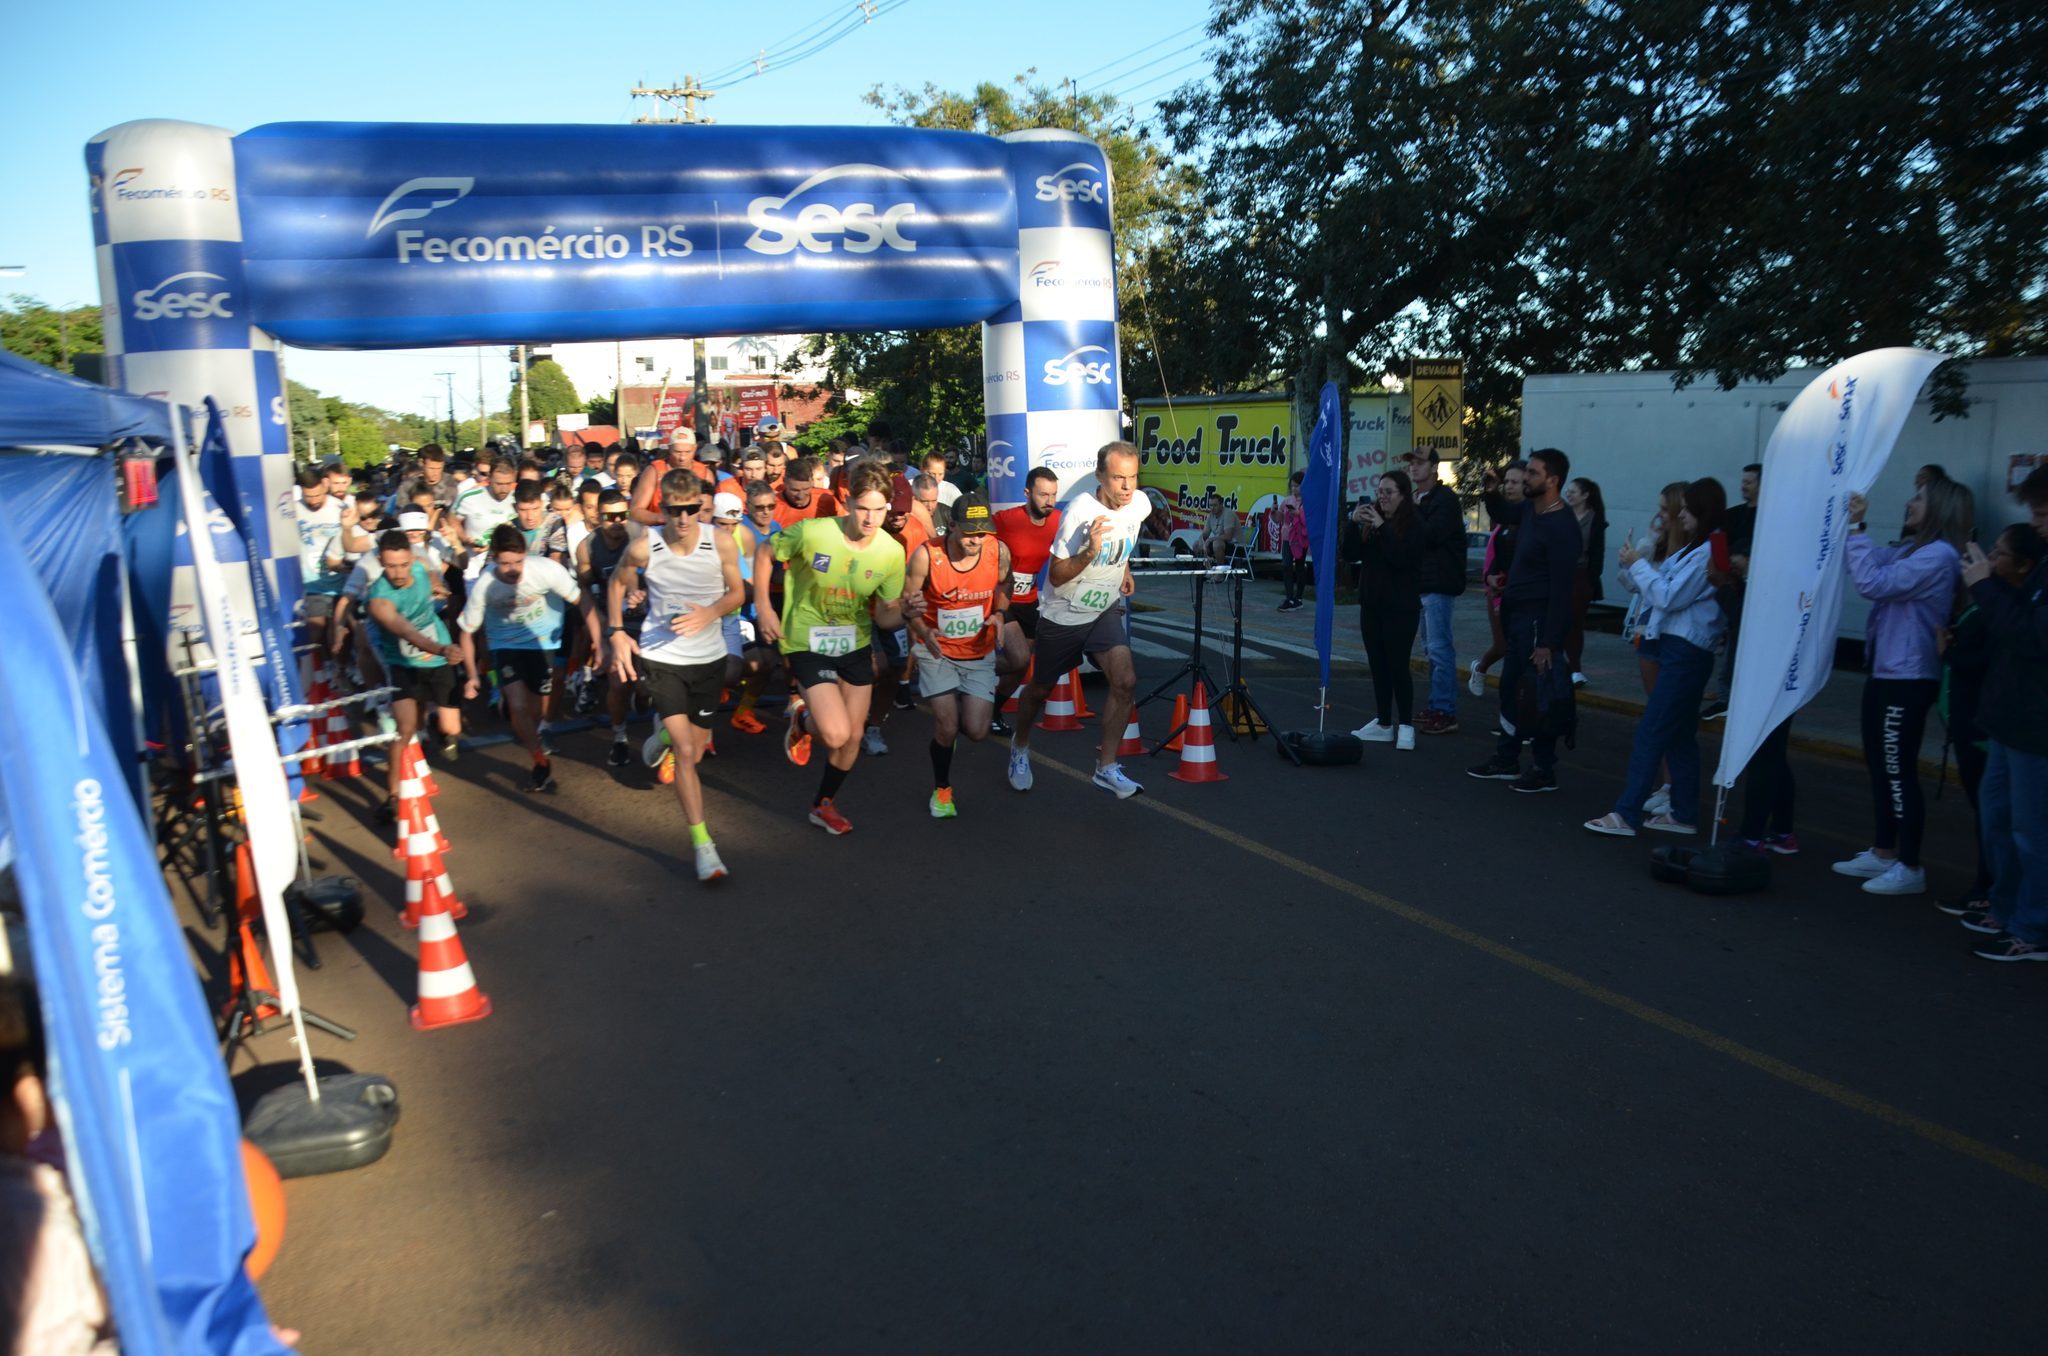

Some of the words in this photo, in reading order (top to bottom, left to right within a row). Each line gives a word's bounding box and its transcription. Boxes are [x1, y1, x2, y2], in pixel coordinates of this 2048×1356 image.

[1036, 175, 1104, 204] Sesc
[743, 195, 918, 255] Sesc
[397, 226, 630, 263] Fecomércio
[641, 224, 693, 259] RS
[133, 289, 234, 320] Sesc
[1006, 370, 1020, 381] RS
[1043, 358, 1112, 386] Sesc
[1416, 365, 1459, 376] DEVAGAR
[1141, 415, 1203, 466] Food
[1216, 414, 1287, 466] Truck
[1832, 441, 1848, 476] Sesc
[1013, 581, 1032, 593] 67
[1081, 589, 1110, 609] 423
[944, 618, 980, 636] 494
[817, 637, 850, 656] 479
[1884, 705, 1904, 774] GROWTH
[71, 778, 116, 920] Comércio
[91, 924, 132, 1051] Sistema
